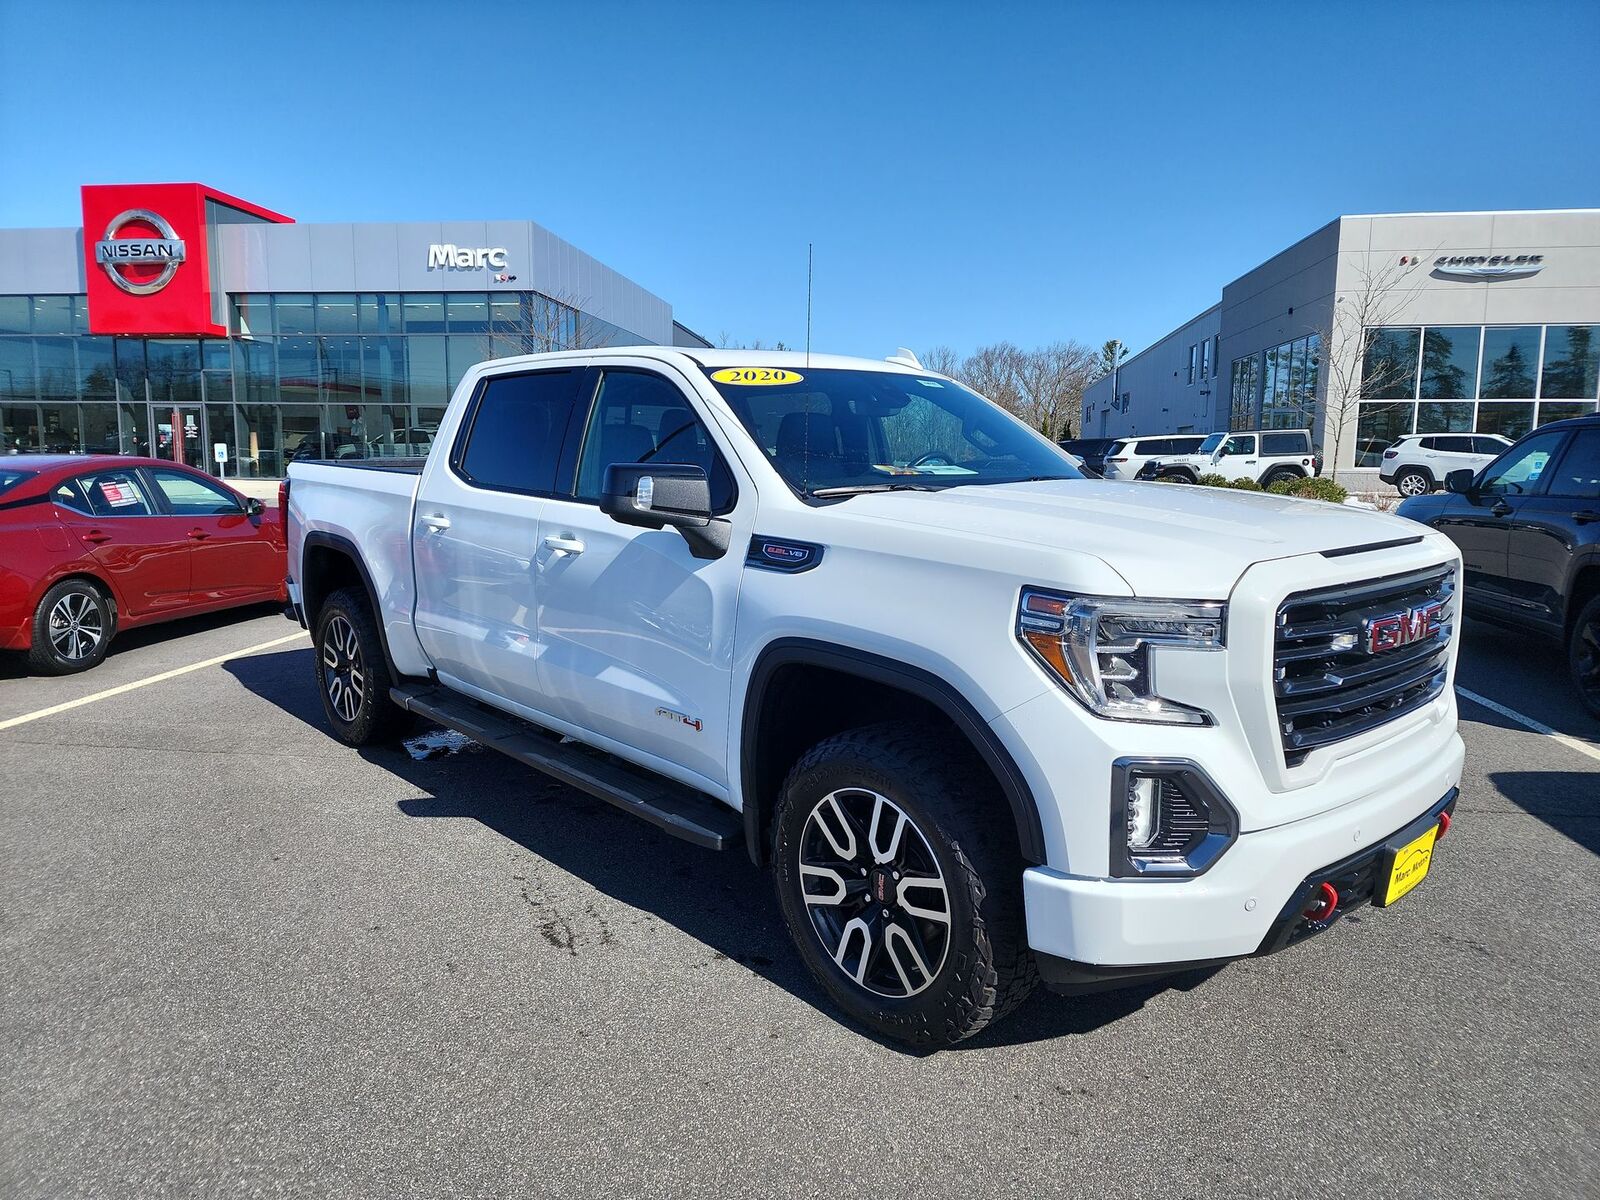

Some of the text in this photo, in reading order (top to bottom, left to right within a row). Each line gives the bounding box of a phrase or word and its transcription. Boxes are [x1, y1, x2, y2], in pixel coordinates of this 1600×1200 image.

[102, 244, 173, 257] NISSAN
[427, 243, 507, 269] Marc
[729, 370, 786, 382] 2020
[1368, 602, 1442, 653] GMC
